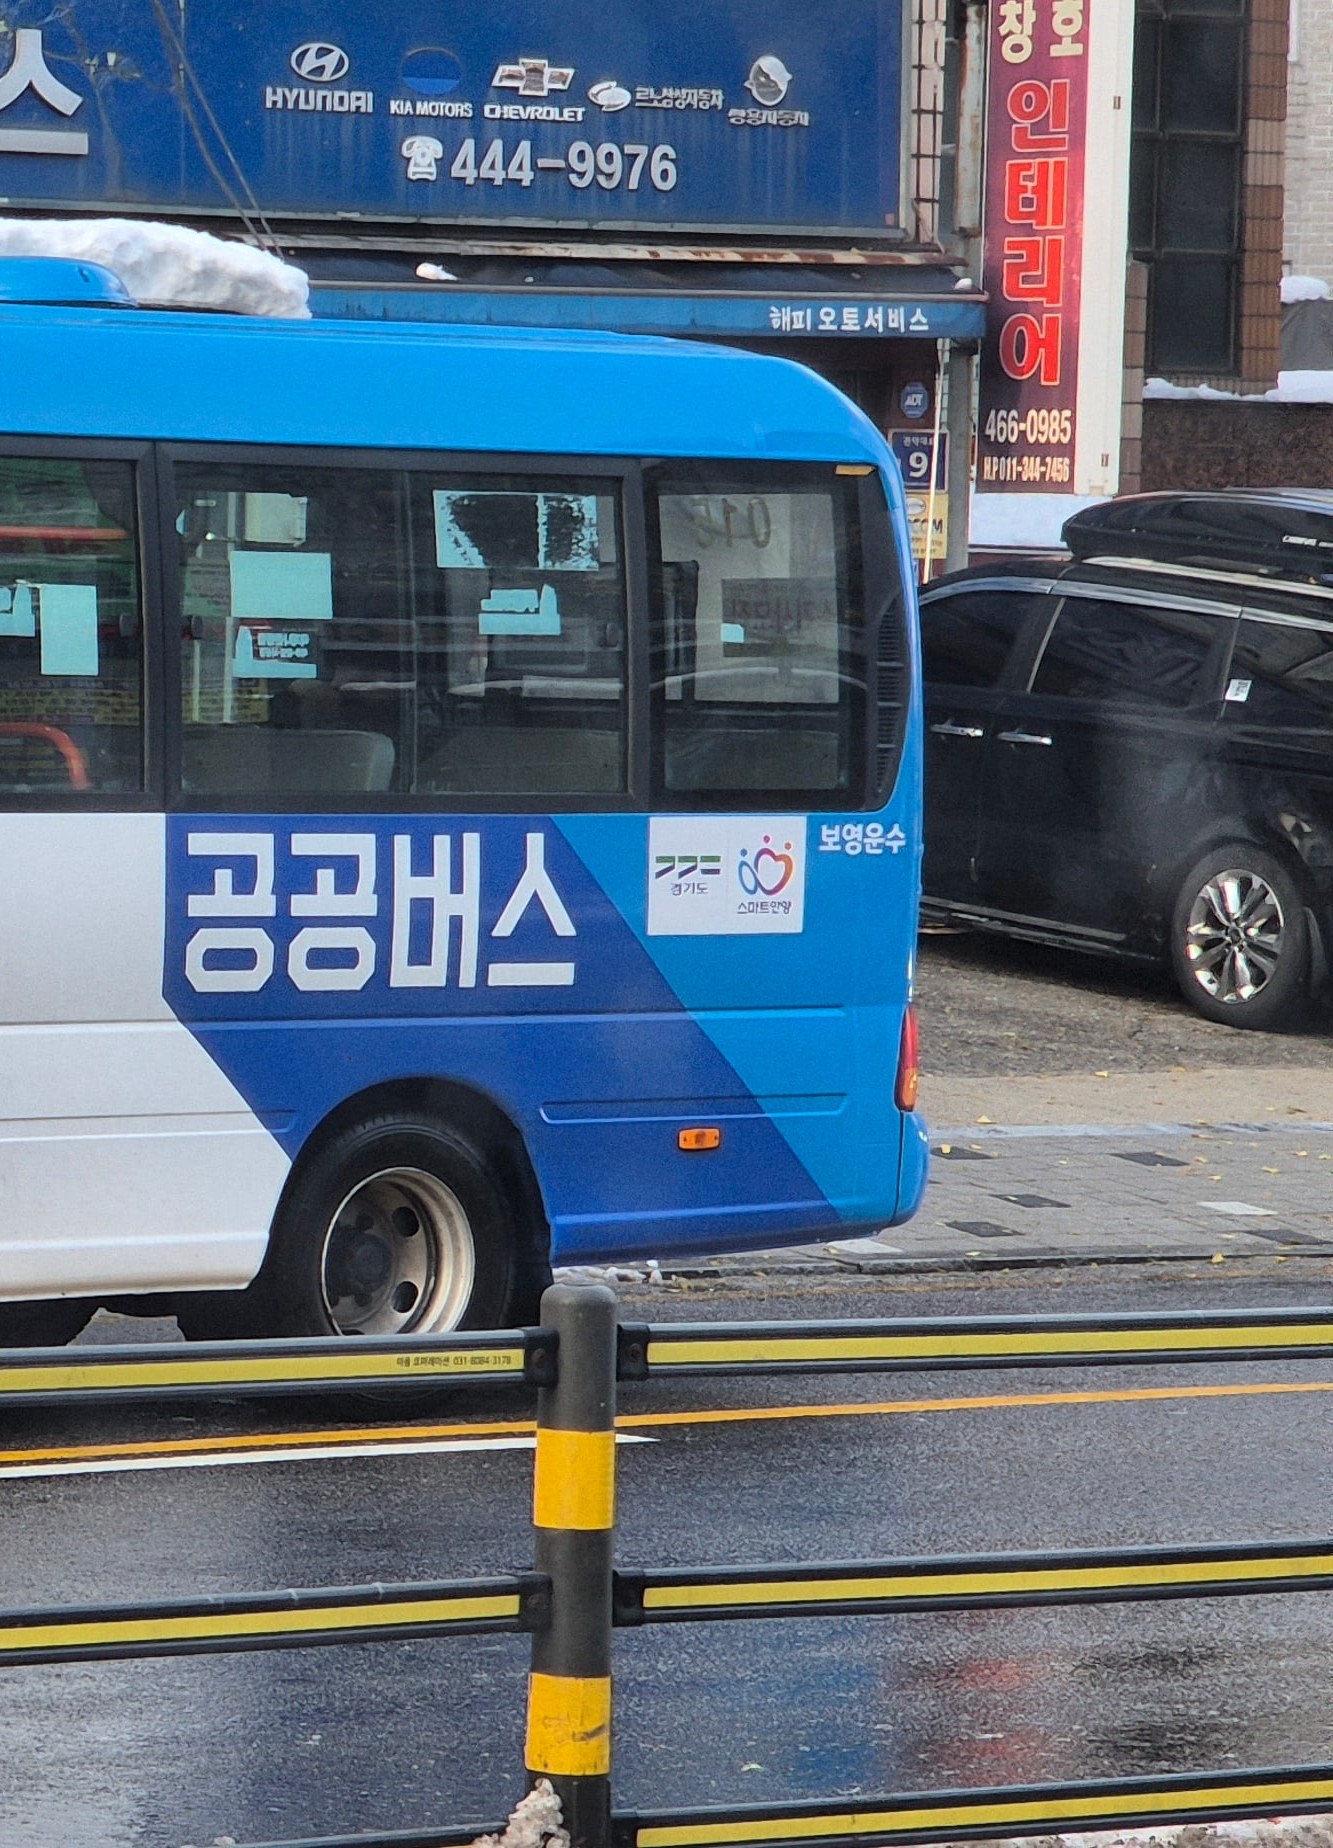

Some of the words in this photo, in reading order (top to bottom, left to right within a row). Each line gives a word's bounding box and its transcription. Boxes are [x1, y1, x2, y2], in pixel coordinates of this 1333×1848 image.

[998, 0, 1083, 63] 창호
[265, 86, 374, 114] HYUNDAI
[389, 100, 414, 116] KIA
[416, 101, 474, 118] MOTORS
[484, 104, 586, 123] CHEVROLET
[451, 138, 678, 191] 444-9976
[1000, 79, 1070, 386] 인테리어
[769, 305, 812, 332] 해피
[817, 306, 930, 334] 오토서비스
[905, 394, 924, 407] ADT
[984, 408, 1072, 444] 466-0985
[819, 822, 907, 856] 보영운수
[670, 882, 710, 896] 경기도
[184, 832, 577, 993] 공공버스
[737, 900, 793, 915] 스마트안양
